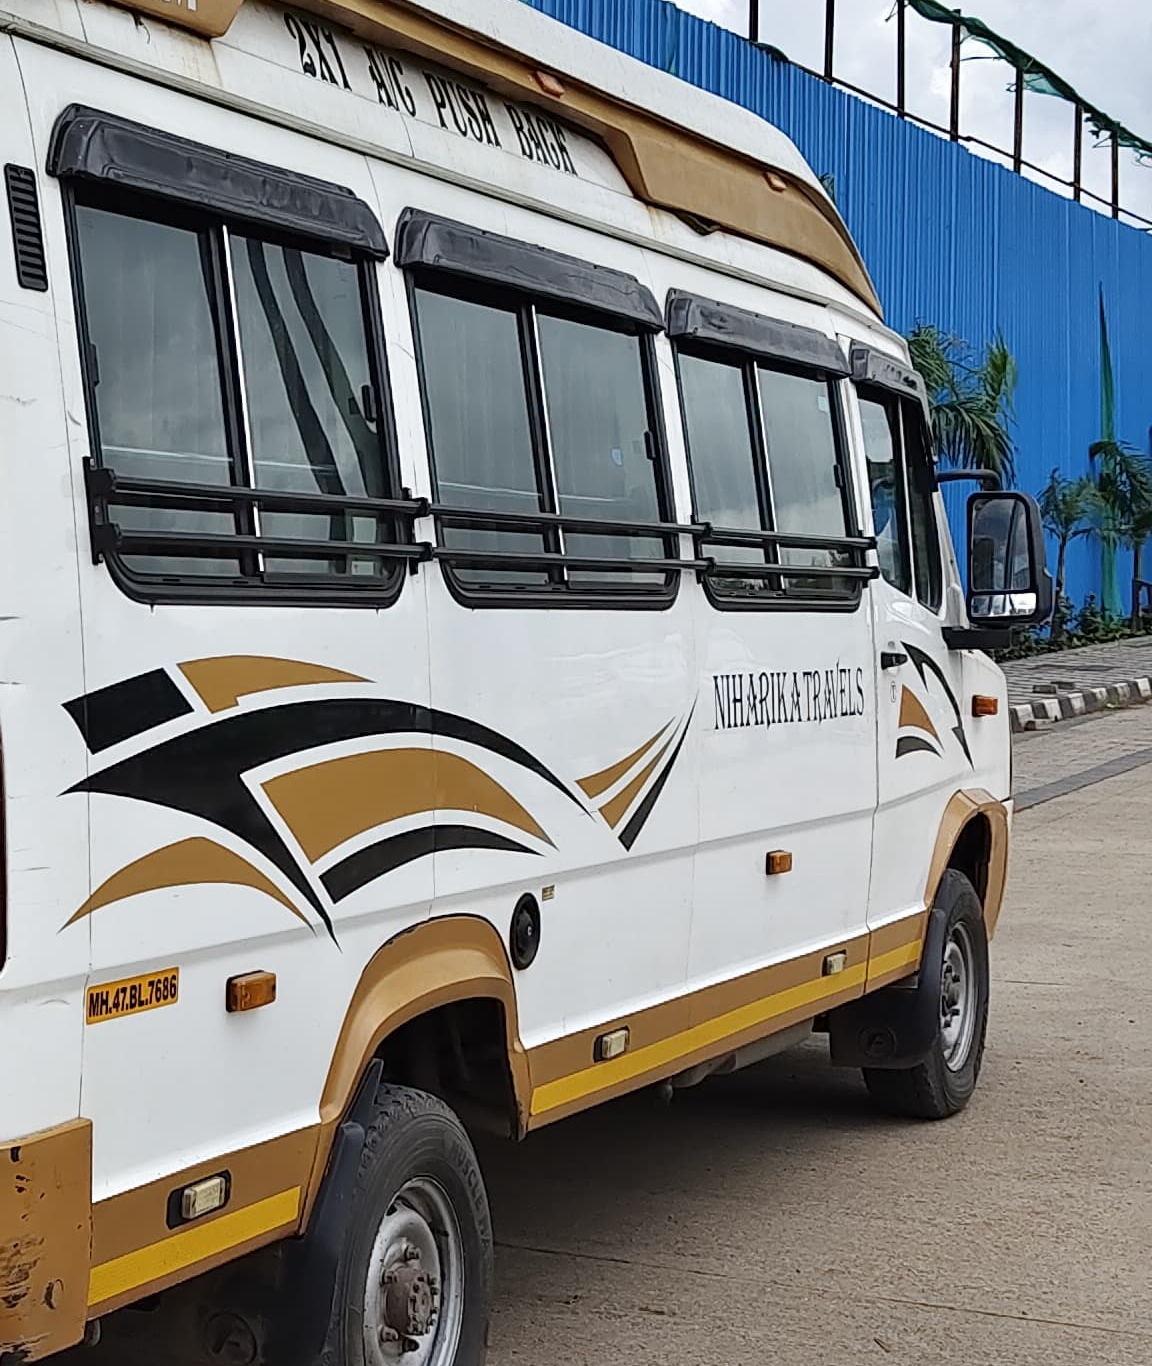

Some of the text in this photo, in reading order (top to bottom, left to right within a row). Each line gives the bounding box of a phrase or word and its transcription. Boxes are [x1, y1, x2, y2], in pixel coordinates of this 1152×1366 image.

[283, 11, 353, 92] 2X1
[422, 69, 503, 149] PUSH
[503, 101, 579, 177] BACK
[713, 659, 865, 731] NIHARIKA TRAVELS
[88, 974, 177, 1018] MH.47.BL.7686
